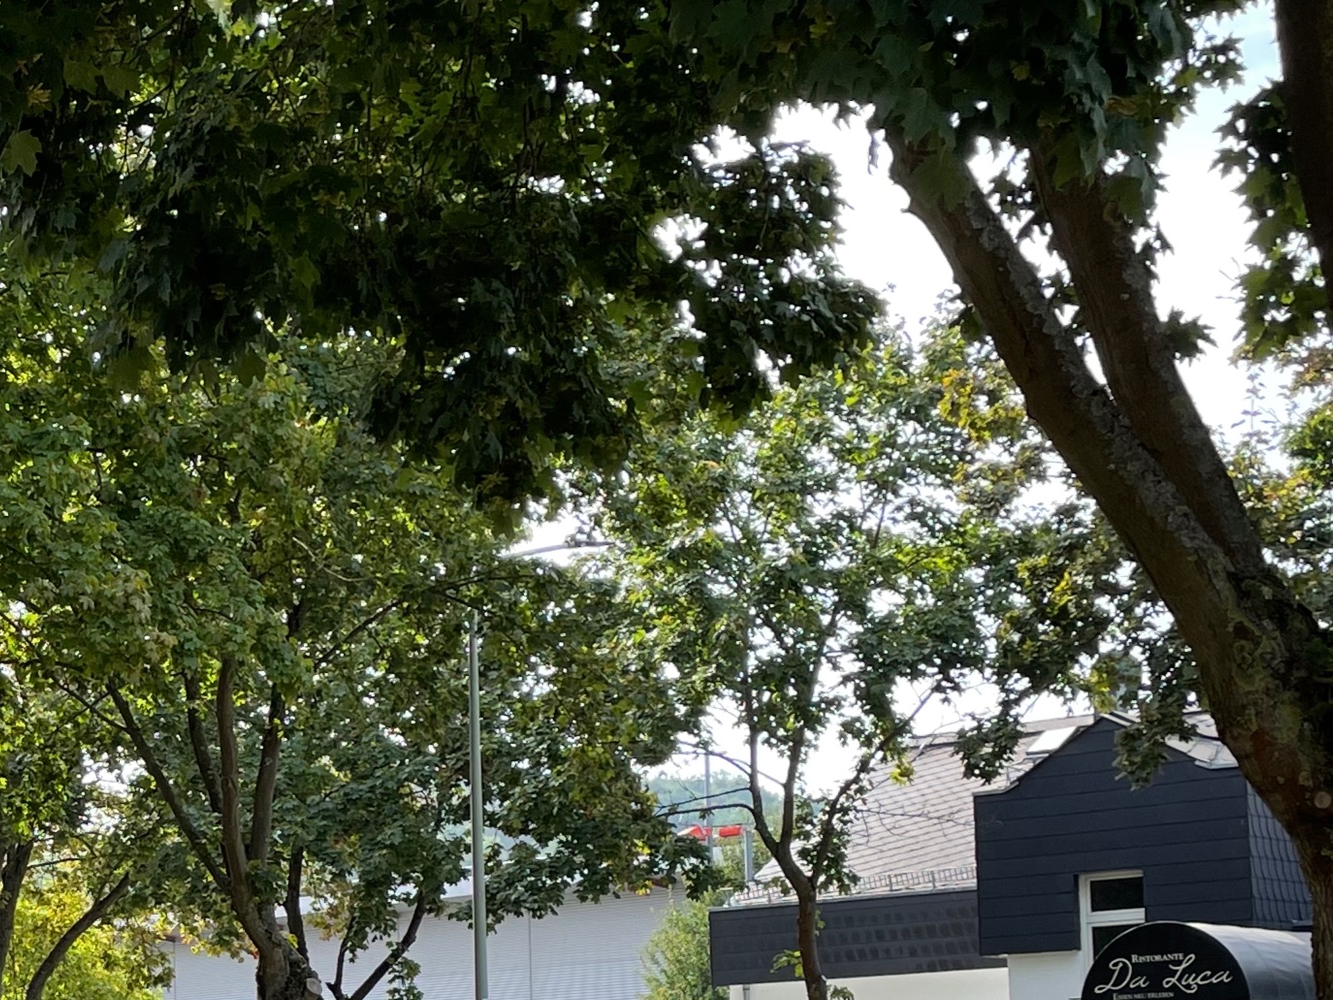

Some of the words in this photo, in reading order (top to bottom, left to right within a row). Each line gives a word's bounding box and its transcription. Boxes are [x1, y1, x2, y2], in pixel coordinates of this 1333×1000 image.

[1131, 953, 1184, 964] RISTORANTE
[1094, 957, 1150, 994] Da
[1162, 953, 1233, 994] Luca
